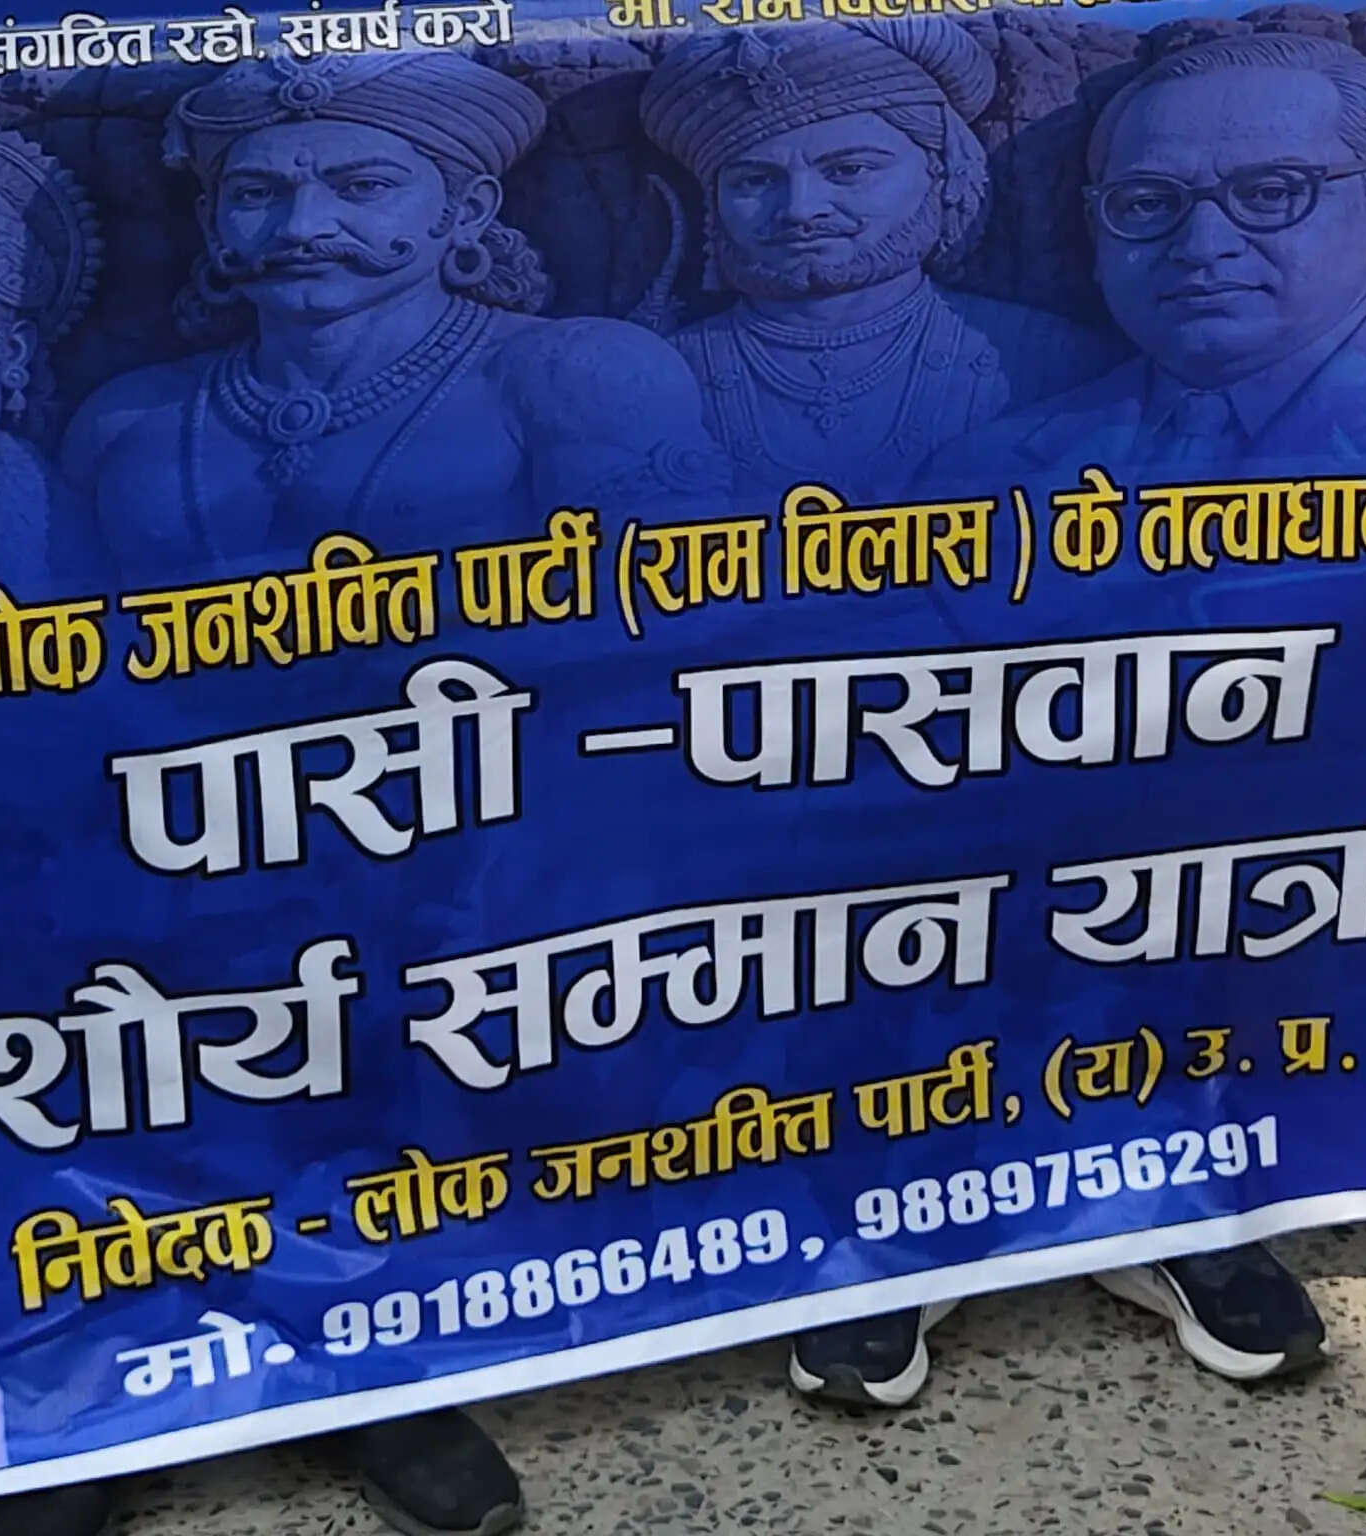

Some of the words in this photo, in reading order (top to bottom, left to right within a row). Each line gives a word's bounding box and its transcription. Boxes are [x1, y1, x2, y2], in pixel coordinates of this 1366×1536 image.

[277, 0, 402, 58] संघर्ष
[120, 536, 436, 687] जनशक्ति
[456, 511, 601, 634] पार्टी
[616, 518, 766, 639] (राम
[782, 489, 997, 598] विलास
[1052, 470, 1128, 579] के
[106, 658, 532, 881] पासी
[402, 867, 1010, 1089] सम्मान
[9, 1190, 275, 1315] निवेदक
[350, 1147, 508, 1247] लोक
[530, 1087, 834, 1204] जनशक्ति
[853, 1048, 1021, 1142] पार्टी,
[1044, 1036, 1162, 1120] (रा)
[115, 1313, 296, 1399] मो.
[852, 1114, 1282, 1243] 9889756291
